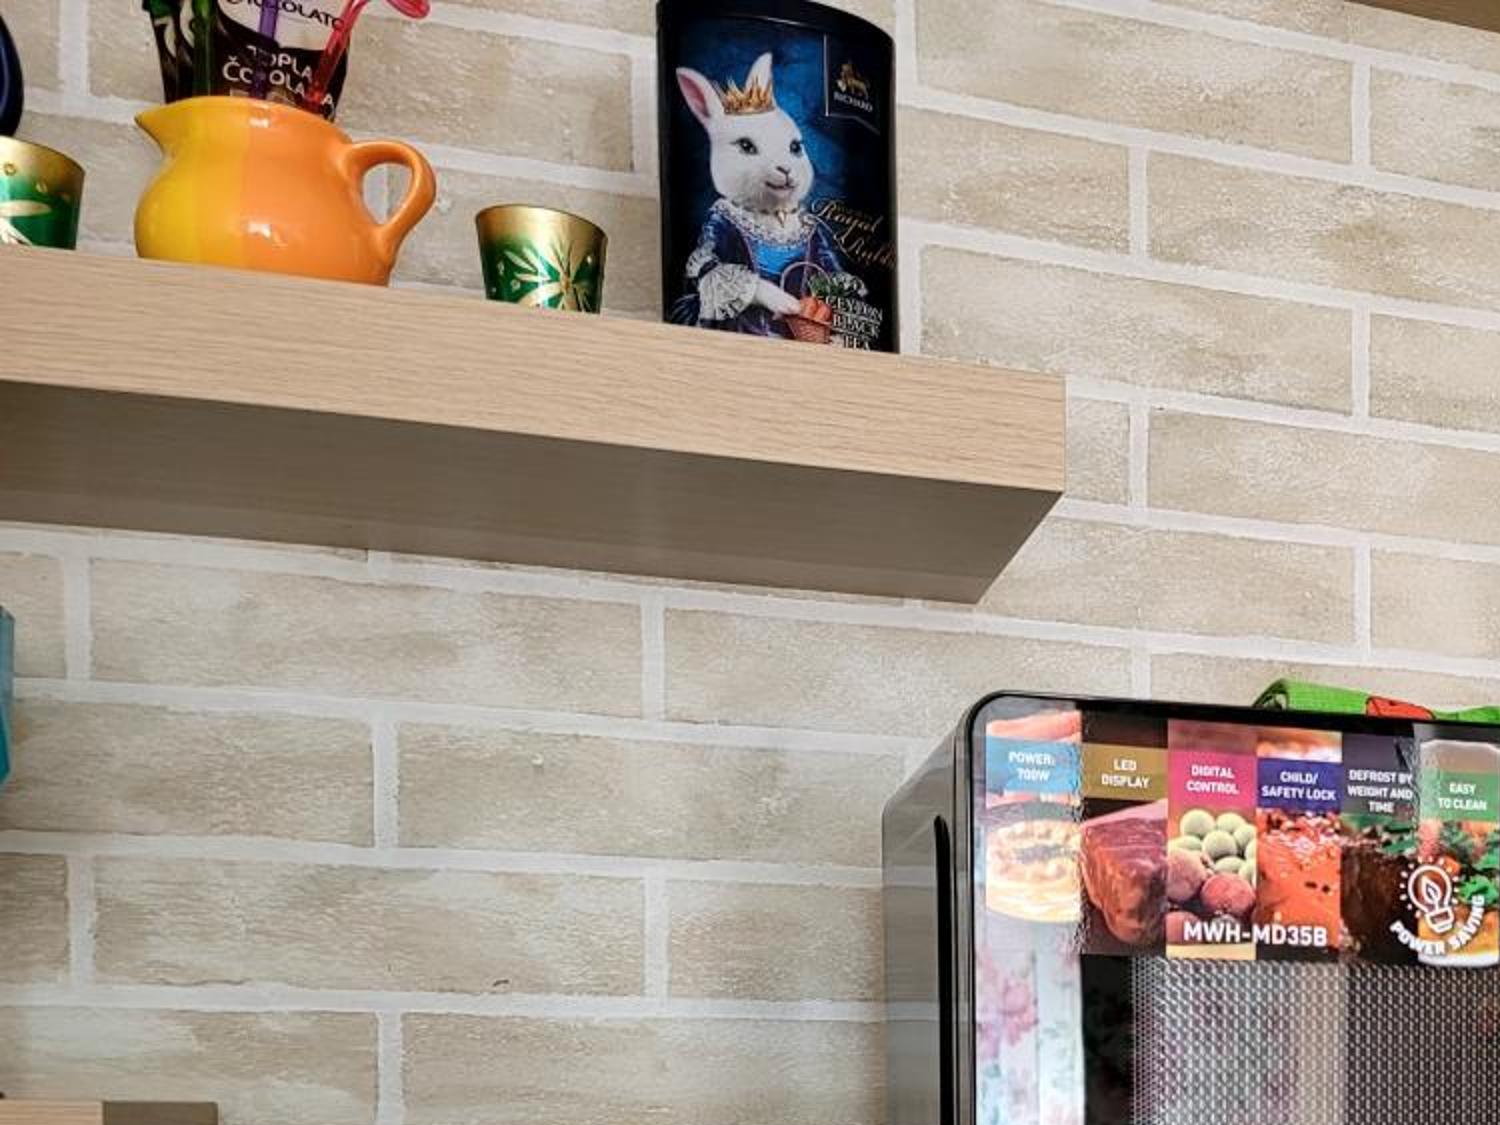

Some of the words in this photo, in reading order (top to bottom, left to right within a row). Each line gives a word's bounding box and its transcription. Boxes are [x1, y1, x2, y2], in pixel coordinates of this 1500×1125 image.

[222, 56, 336, 112] ČOOLAA
[811, 199, 884, 243] Royal
[1008, 752, 1055, 766] POWER:
[1114, 759, 1137, 771] LED
[1016, 768, 1050, 782] 700W
[1191, 765, 1236, 779] DIGITAL
[1280, 771, 1319, 785] CHILD/
[1349, 769, 1396, 783] DEFROST
[1398, 772, 1413, 784] BY
[1101, 774, 1149, 788] DISPLAY
[1186, 780, 1240, 795] CONTROL
[1261, 785, 1304, 799] SAFETY
[1306, 787, 1336, 801] LOCK
[1347, 785, 1389, 799] WEIGHT
[1390, 787, 1413, 800] AND
[1449, 782, 1476, 795] EASY
[1368, 801, 1395, 814] TIME
[1438, 797, 1452, 809] TO
[1453, 798, 1487, 811] CLEAN
[1389, 920, 1446, 955] POWER
[1447, 894, 1485, 950] SAVING
[1183, 921, 1328, 947] MWH-MD35B
